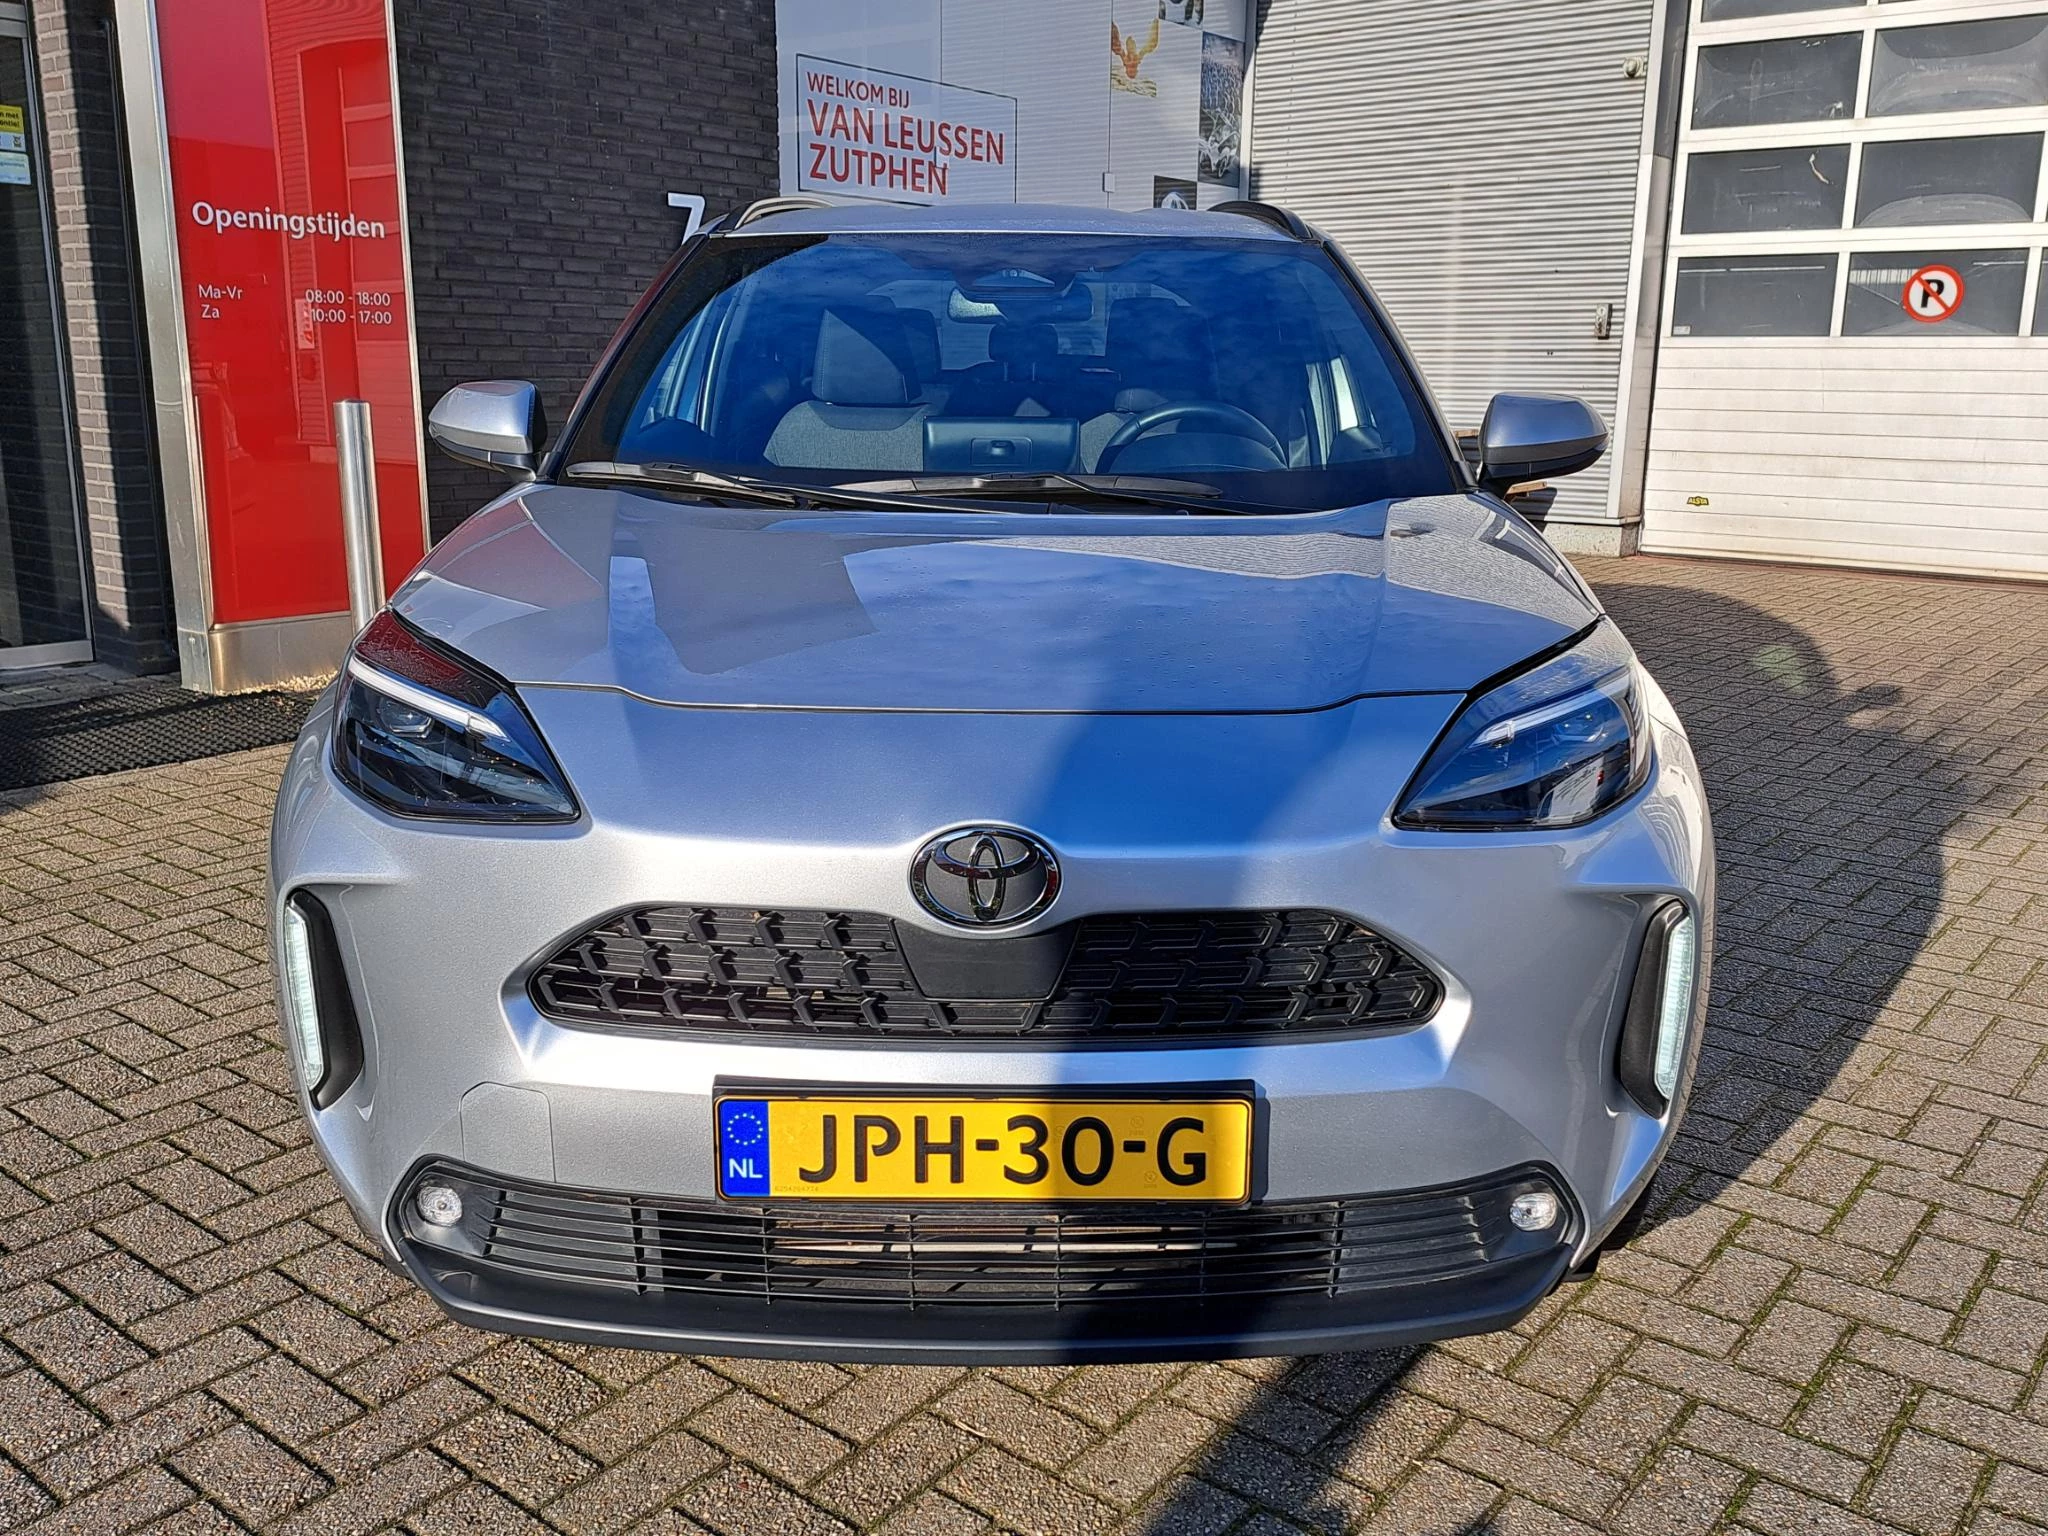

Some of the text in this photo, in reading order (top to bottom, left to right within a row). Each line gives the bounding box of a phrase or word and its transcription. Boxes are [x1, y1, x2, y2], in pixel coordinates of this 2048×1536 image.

[806, 71, 910, 109] WELKOM BIJ
[807, 98, 1004, 166] VAN LEUSSEN
[808, 142, 949, 196] ZUTPHEN
[192, 201, 386, 242] Openingstijden
[198, 284, 243, 300] Ma-Vr
[305, 288, 344, 304] 08:00
[357, 291, 391, 306] 18:00
[201, 304, 220, 319] Za
[311, 308, 346, 323] 10:00
[358, 310, 392, 325] 17:00
[728, 1157, 763, 1179] NL
[799, 1114, 1207, 1186] JPH-30-G
